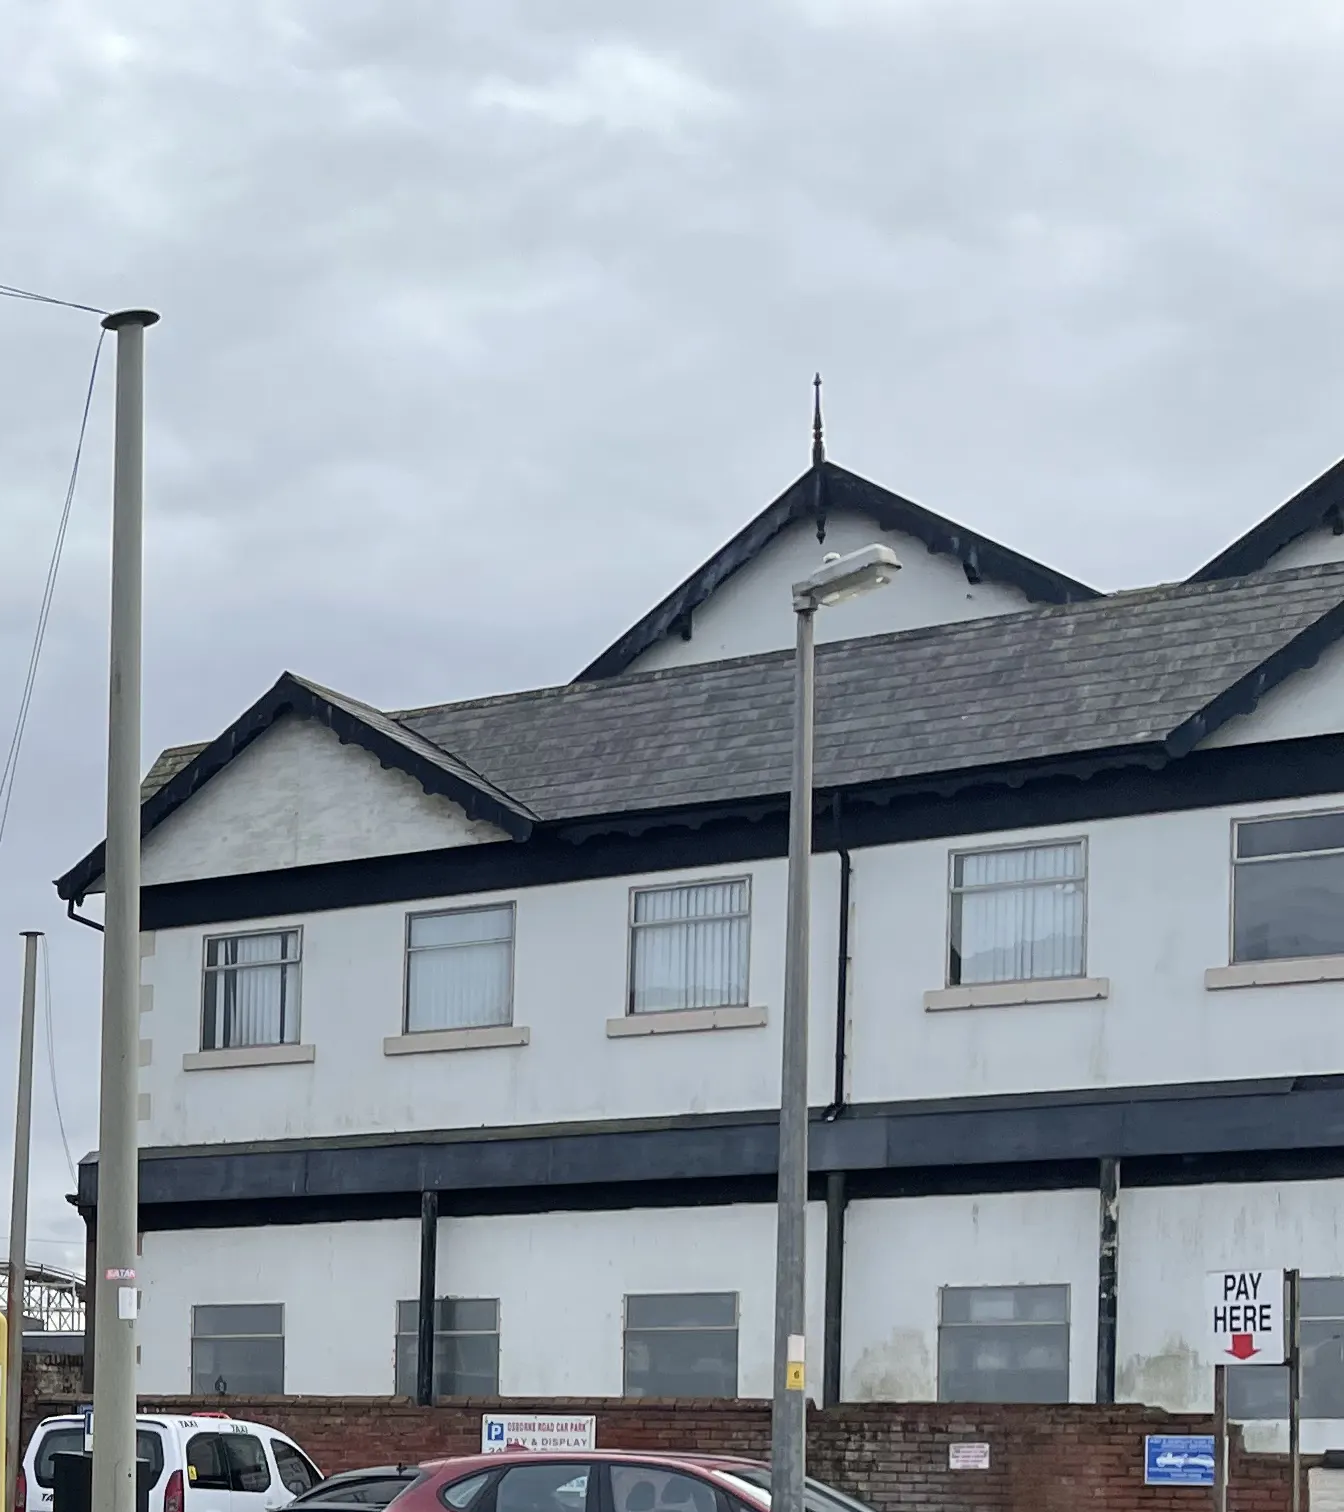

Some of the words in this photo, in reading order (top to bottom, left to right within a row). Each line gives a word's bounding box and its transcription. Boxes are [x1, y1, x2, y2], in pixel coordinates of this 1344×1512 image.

[1224, 1272, 1262, 1301] PAY
[1214, 1304, 1272, 1333] HERE
[178, 1420, 198, 1428] TAXI
[230, 1424, 248, 1433] TAXI
[507, 1422, 535, 1432] OSBORNE
[538, 1422, 554, 1432] ROAD
[556, 1422, 568, 1432] CAR
[570, 1422, 587, 1432] PARK
[506, 1437, 527, 1446] PAY
[541, 1438, 587, 1446] DISPLAY
